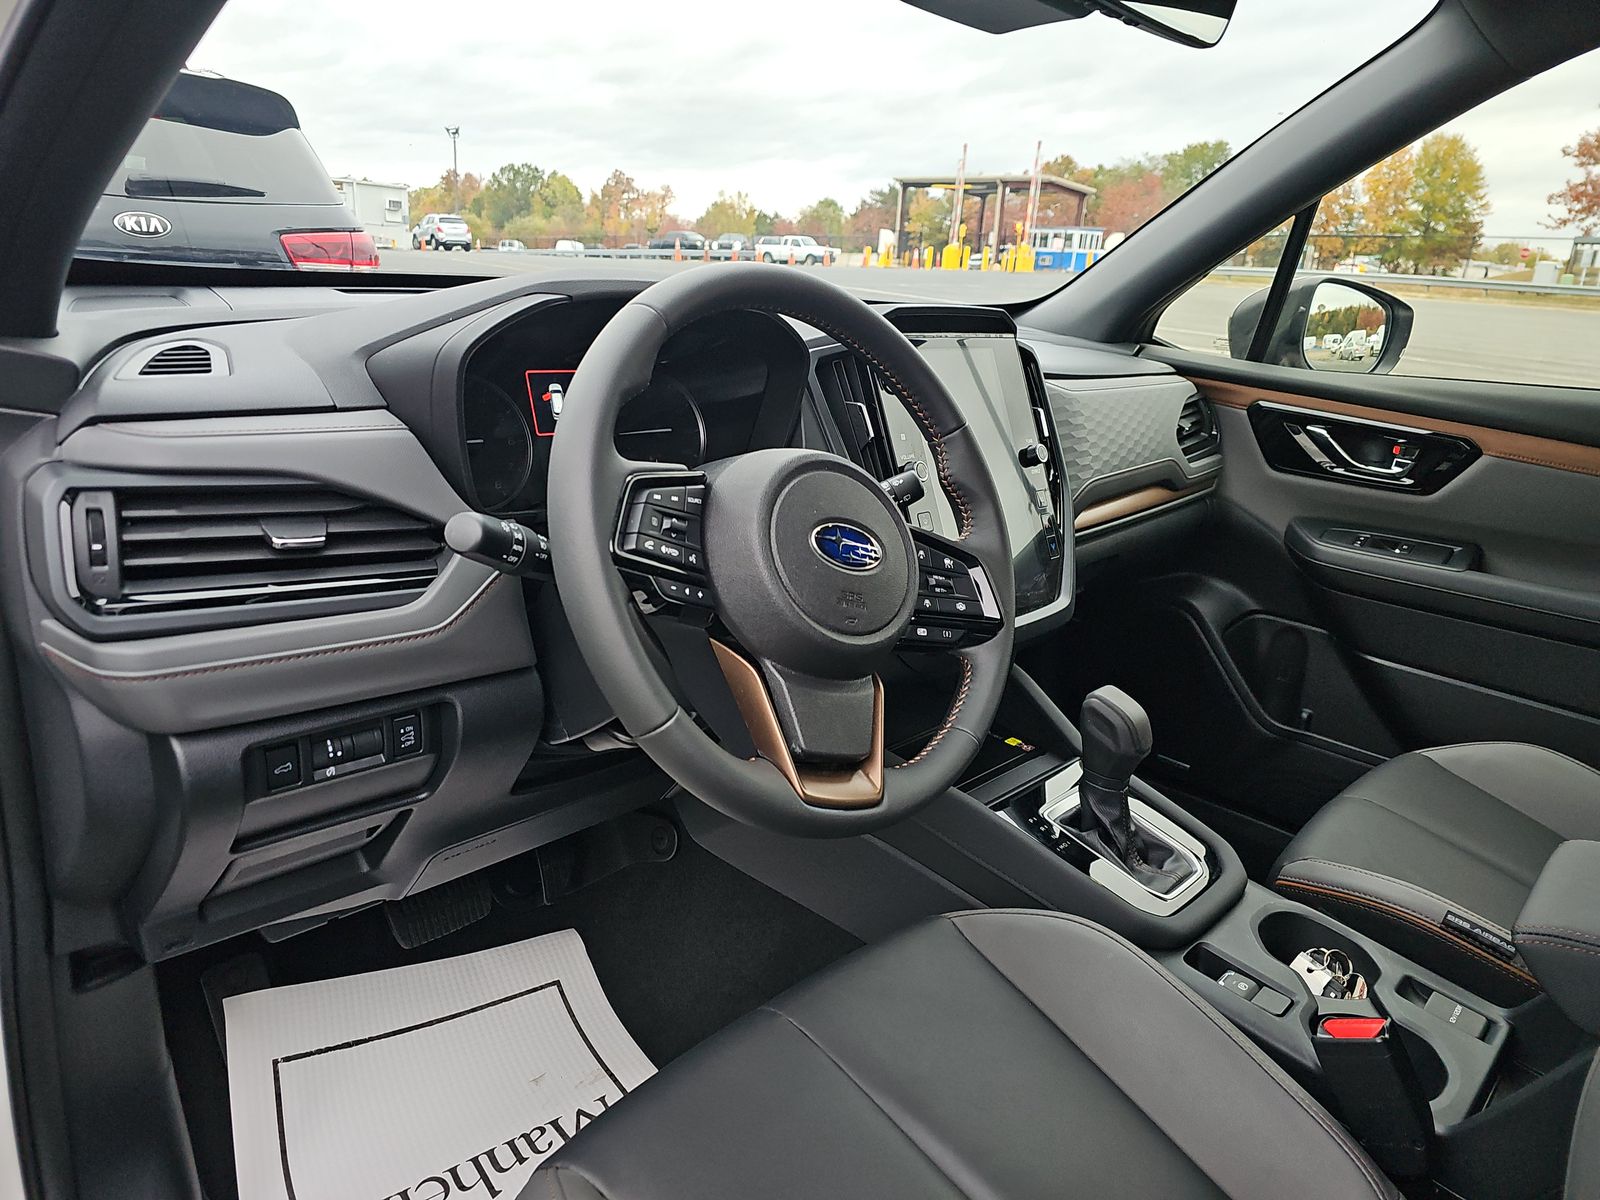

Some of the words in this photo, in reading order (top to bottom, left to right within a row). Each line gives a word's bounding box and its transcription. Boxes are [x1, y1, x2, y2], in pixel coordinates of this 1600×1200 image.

[123, 215, 164, 233] KIA
[507, 555, 519, 563] OFF
[1446, 914, 1471, 929] SRS
[1473, 928, 1516, 954] AIRBAG
